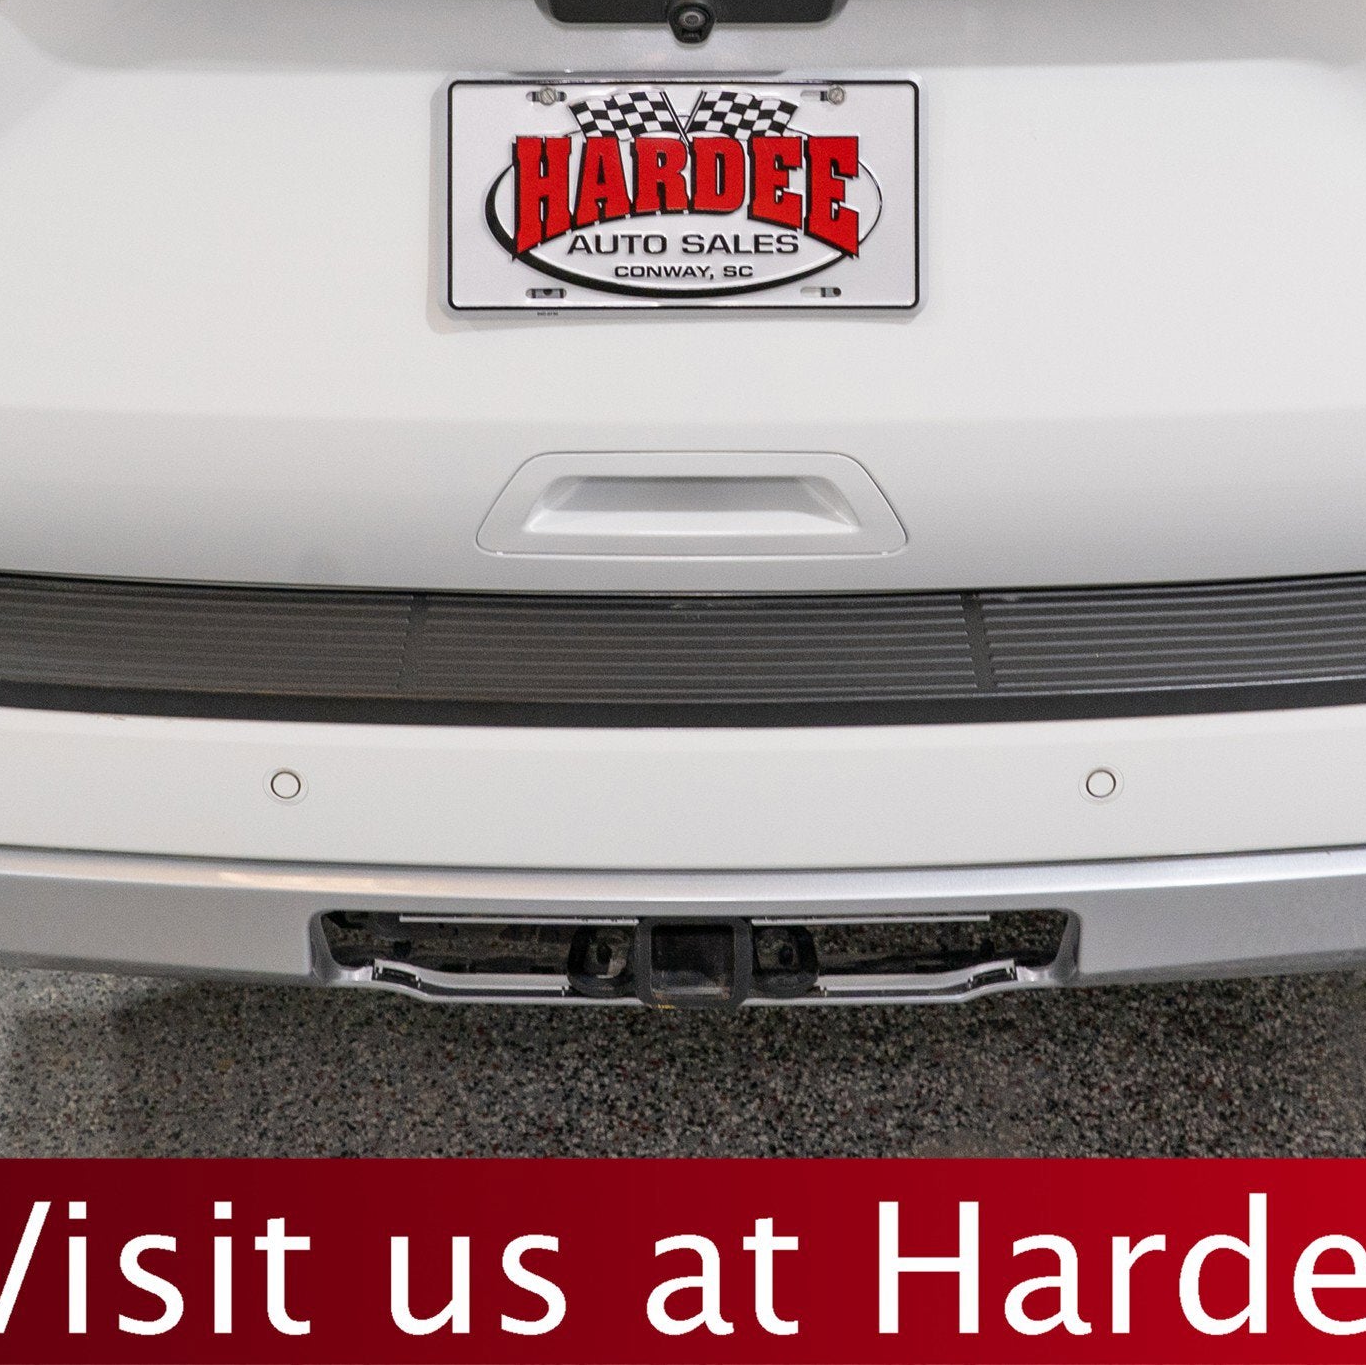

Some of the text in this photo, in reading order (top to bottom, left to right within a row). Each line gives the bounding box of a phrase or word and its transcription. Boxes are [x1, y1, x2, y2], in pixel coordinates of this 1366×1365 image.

[512, 136, 860, 260] HARDEE
[567, 234, 799, 255] AUTO SALES
[614, 266, 754, 280] CONWAY, SC
